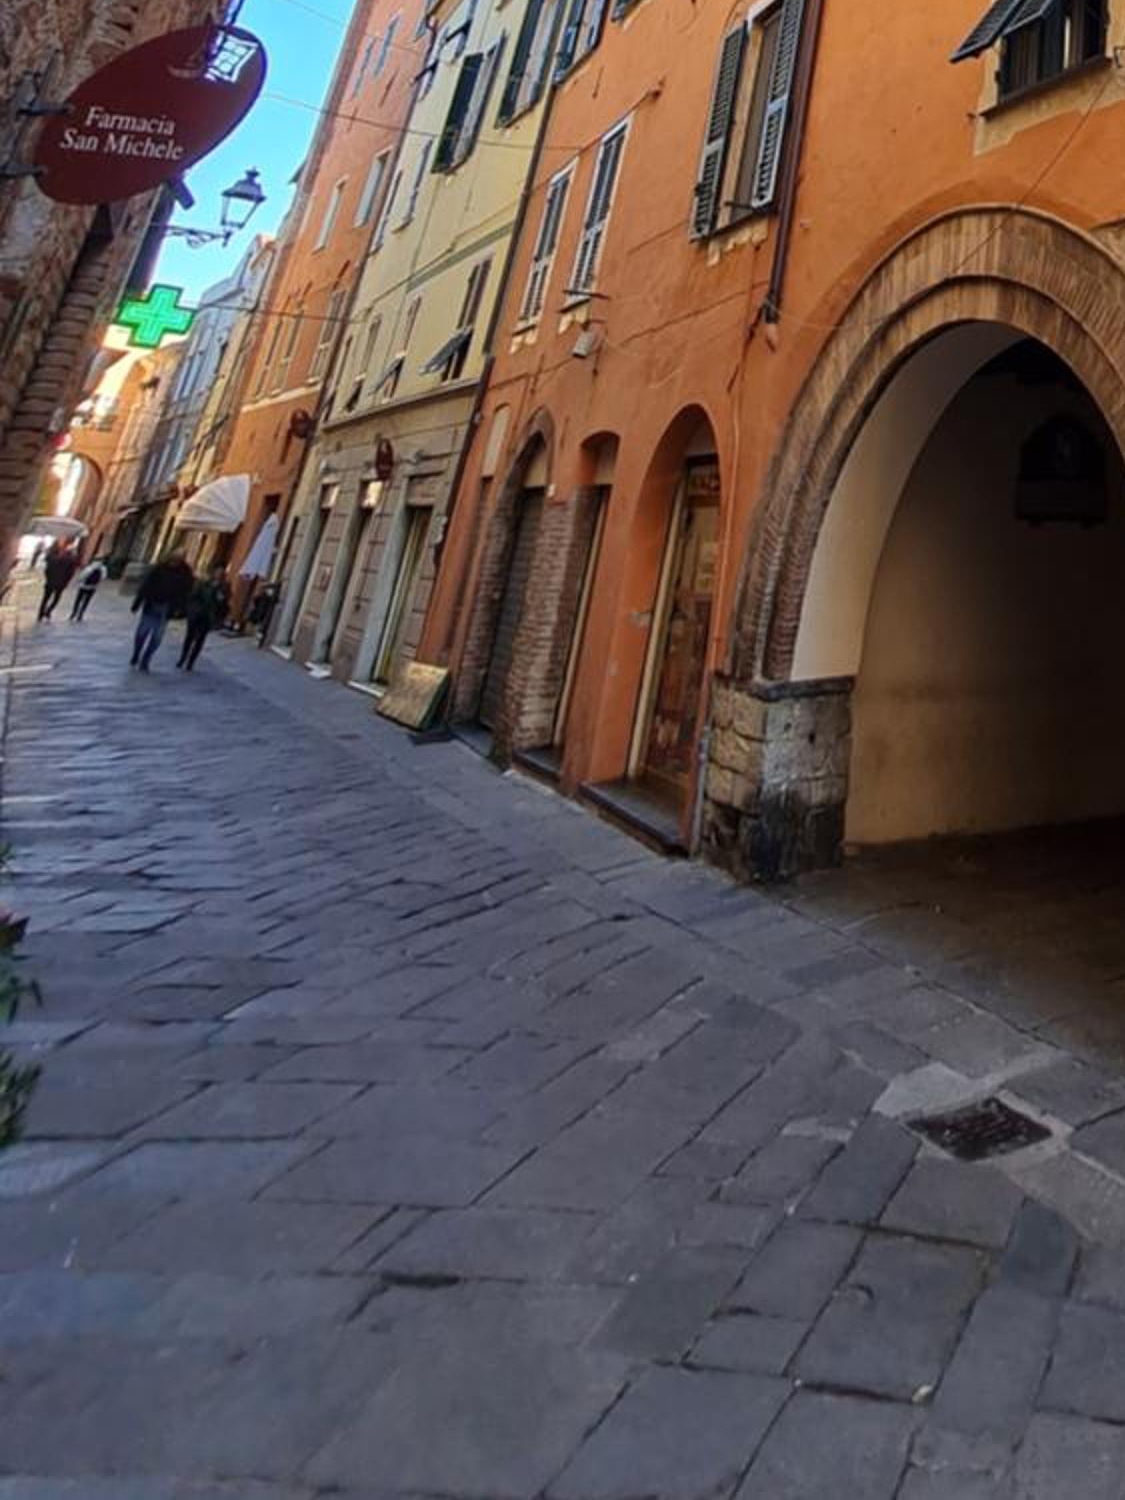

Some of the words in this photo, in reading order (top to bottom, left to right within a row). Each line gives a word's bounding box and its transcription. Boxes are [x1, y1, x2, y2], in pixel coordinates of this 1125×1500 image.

[85, 106, 175, 135] Farmacia
[60, 128, 99, 151] San
[104, 132, 183, 160] Michele
